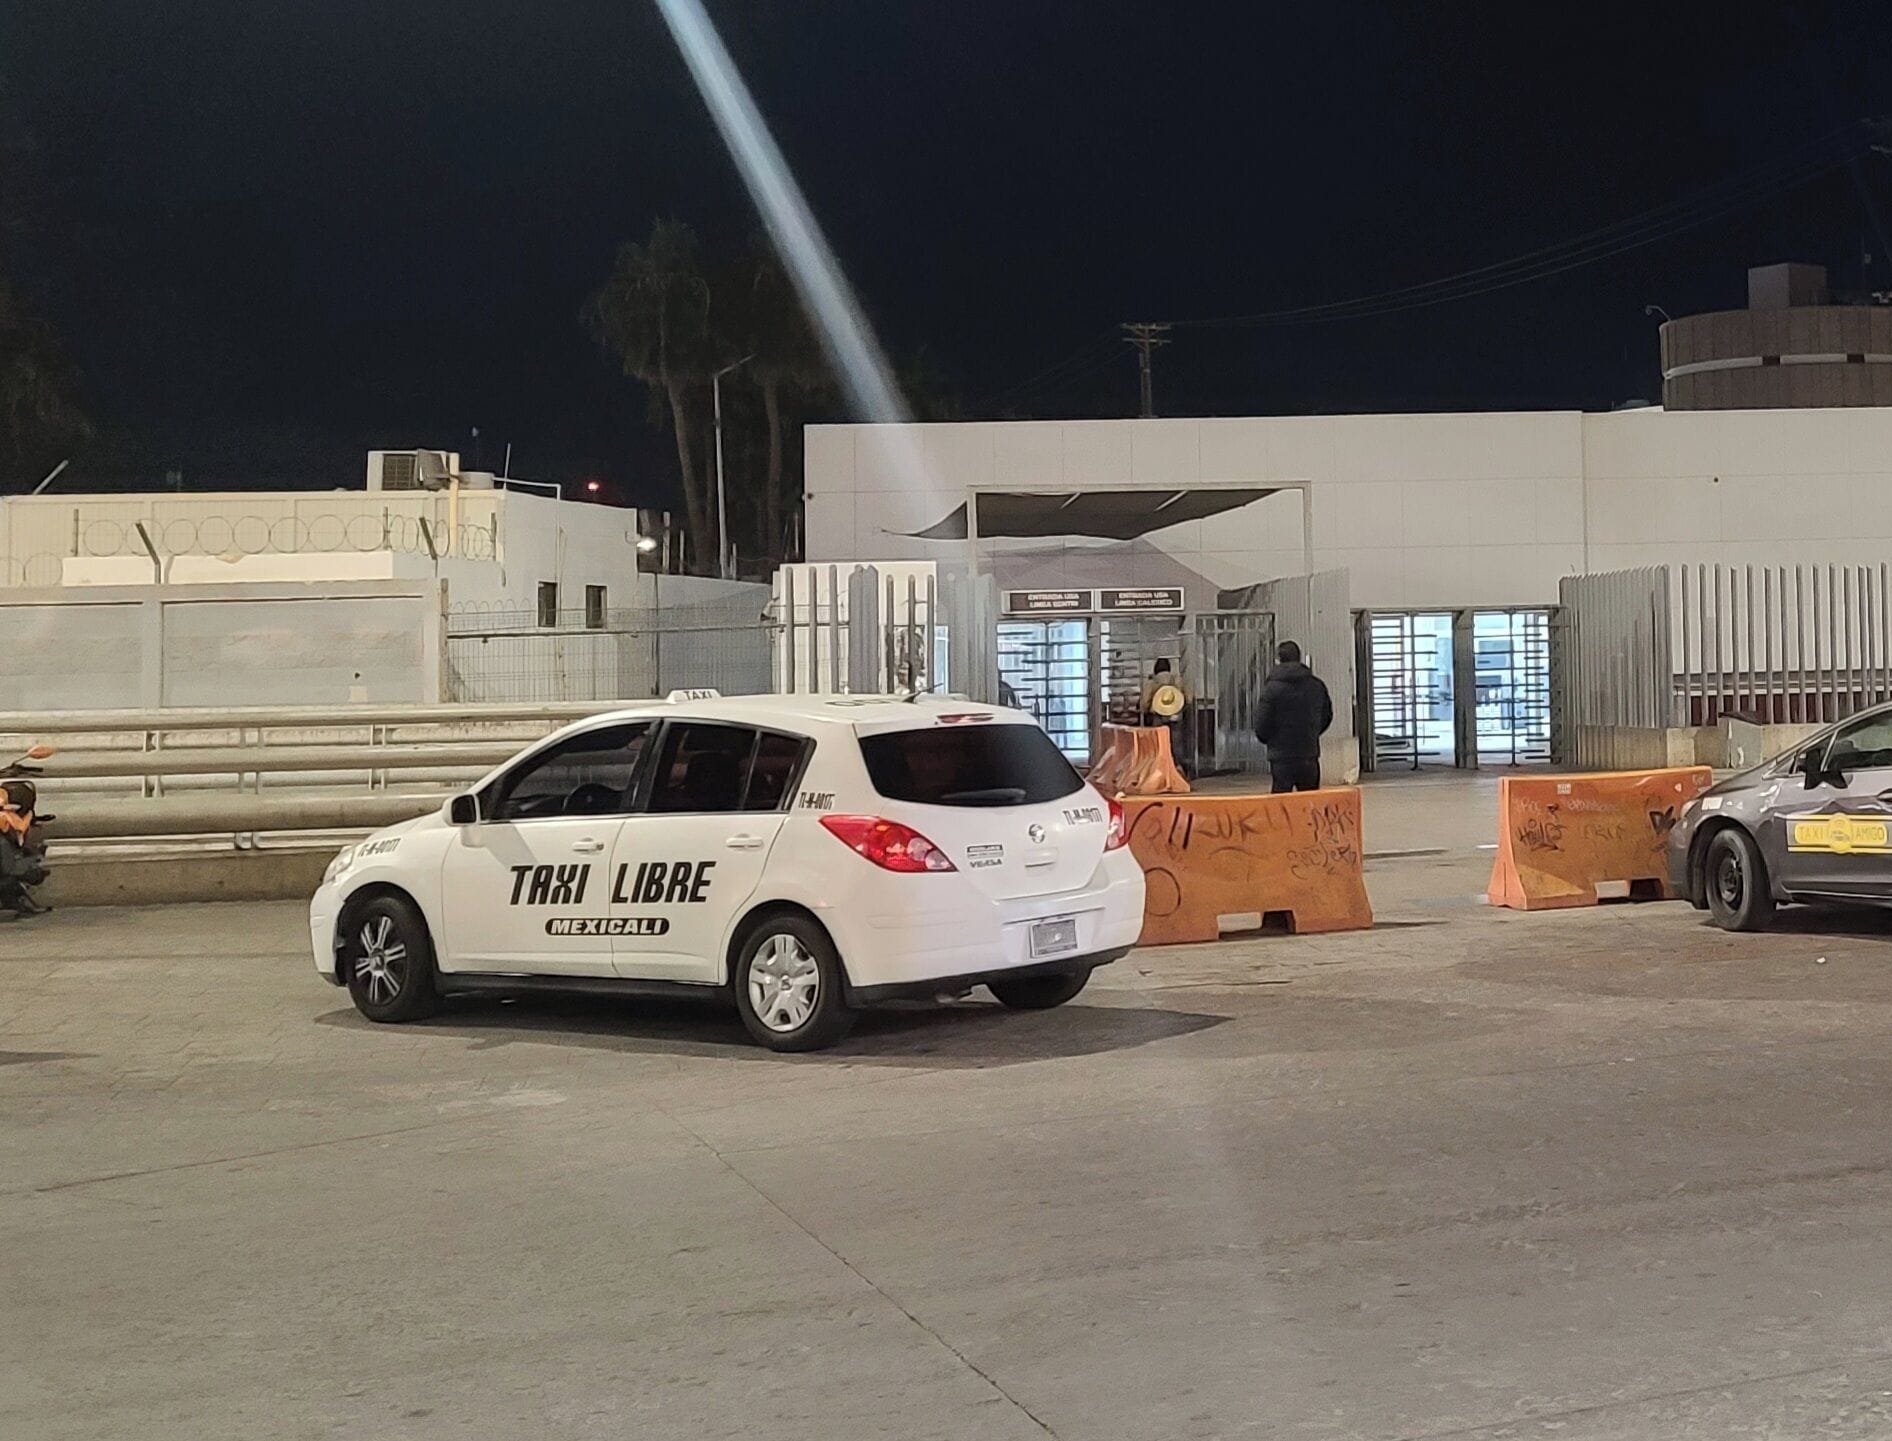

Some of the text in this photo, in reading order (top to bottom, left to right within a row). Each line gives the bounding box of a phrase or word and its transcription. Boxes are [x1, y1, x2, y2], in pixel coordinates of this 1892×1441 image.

[684, 689, 713, 701] TAXI
[1798, 825, 1886, 841] TAXI AMIGO
[509, 860, 717, 906] TAXI LIBRE
[549, 918, 664, 935] MEXICALI
